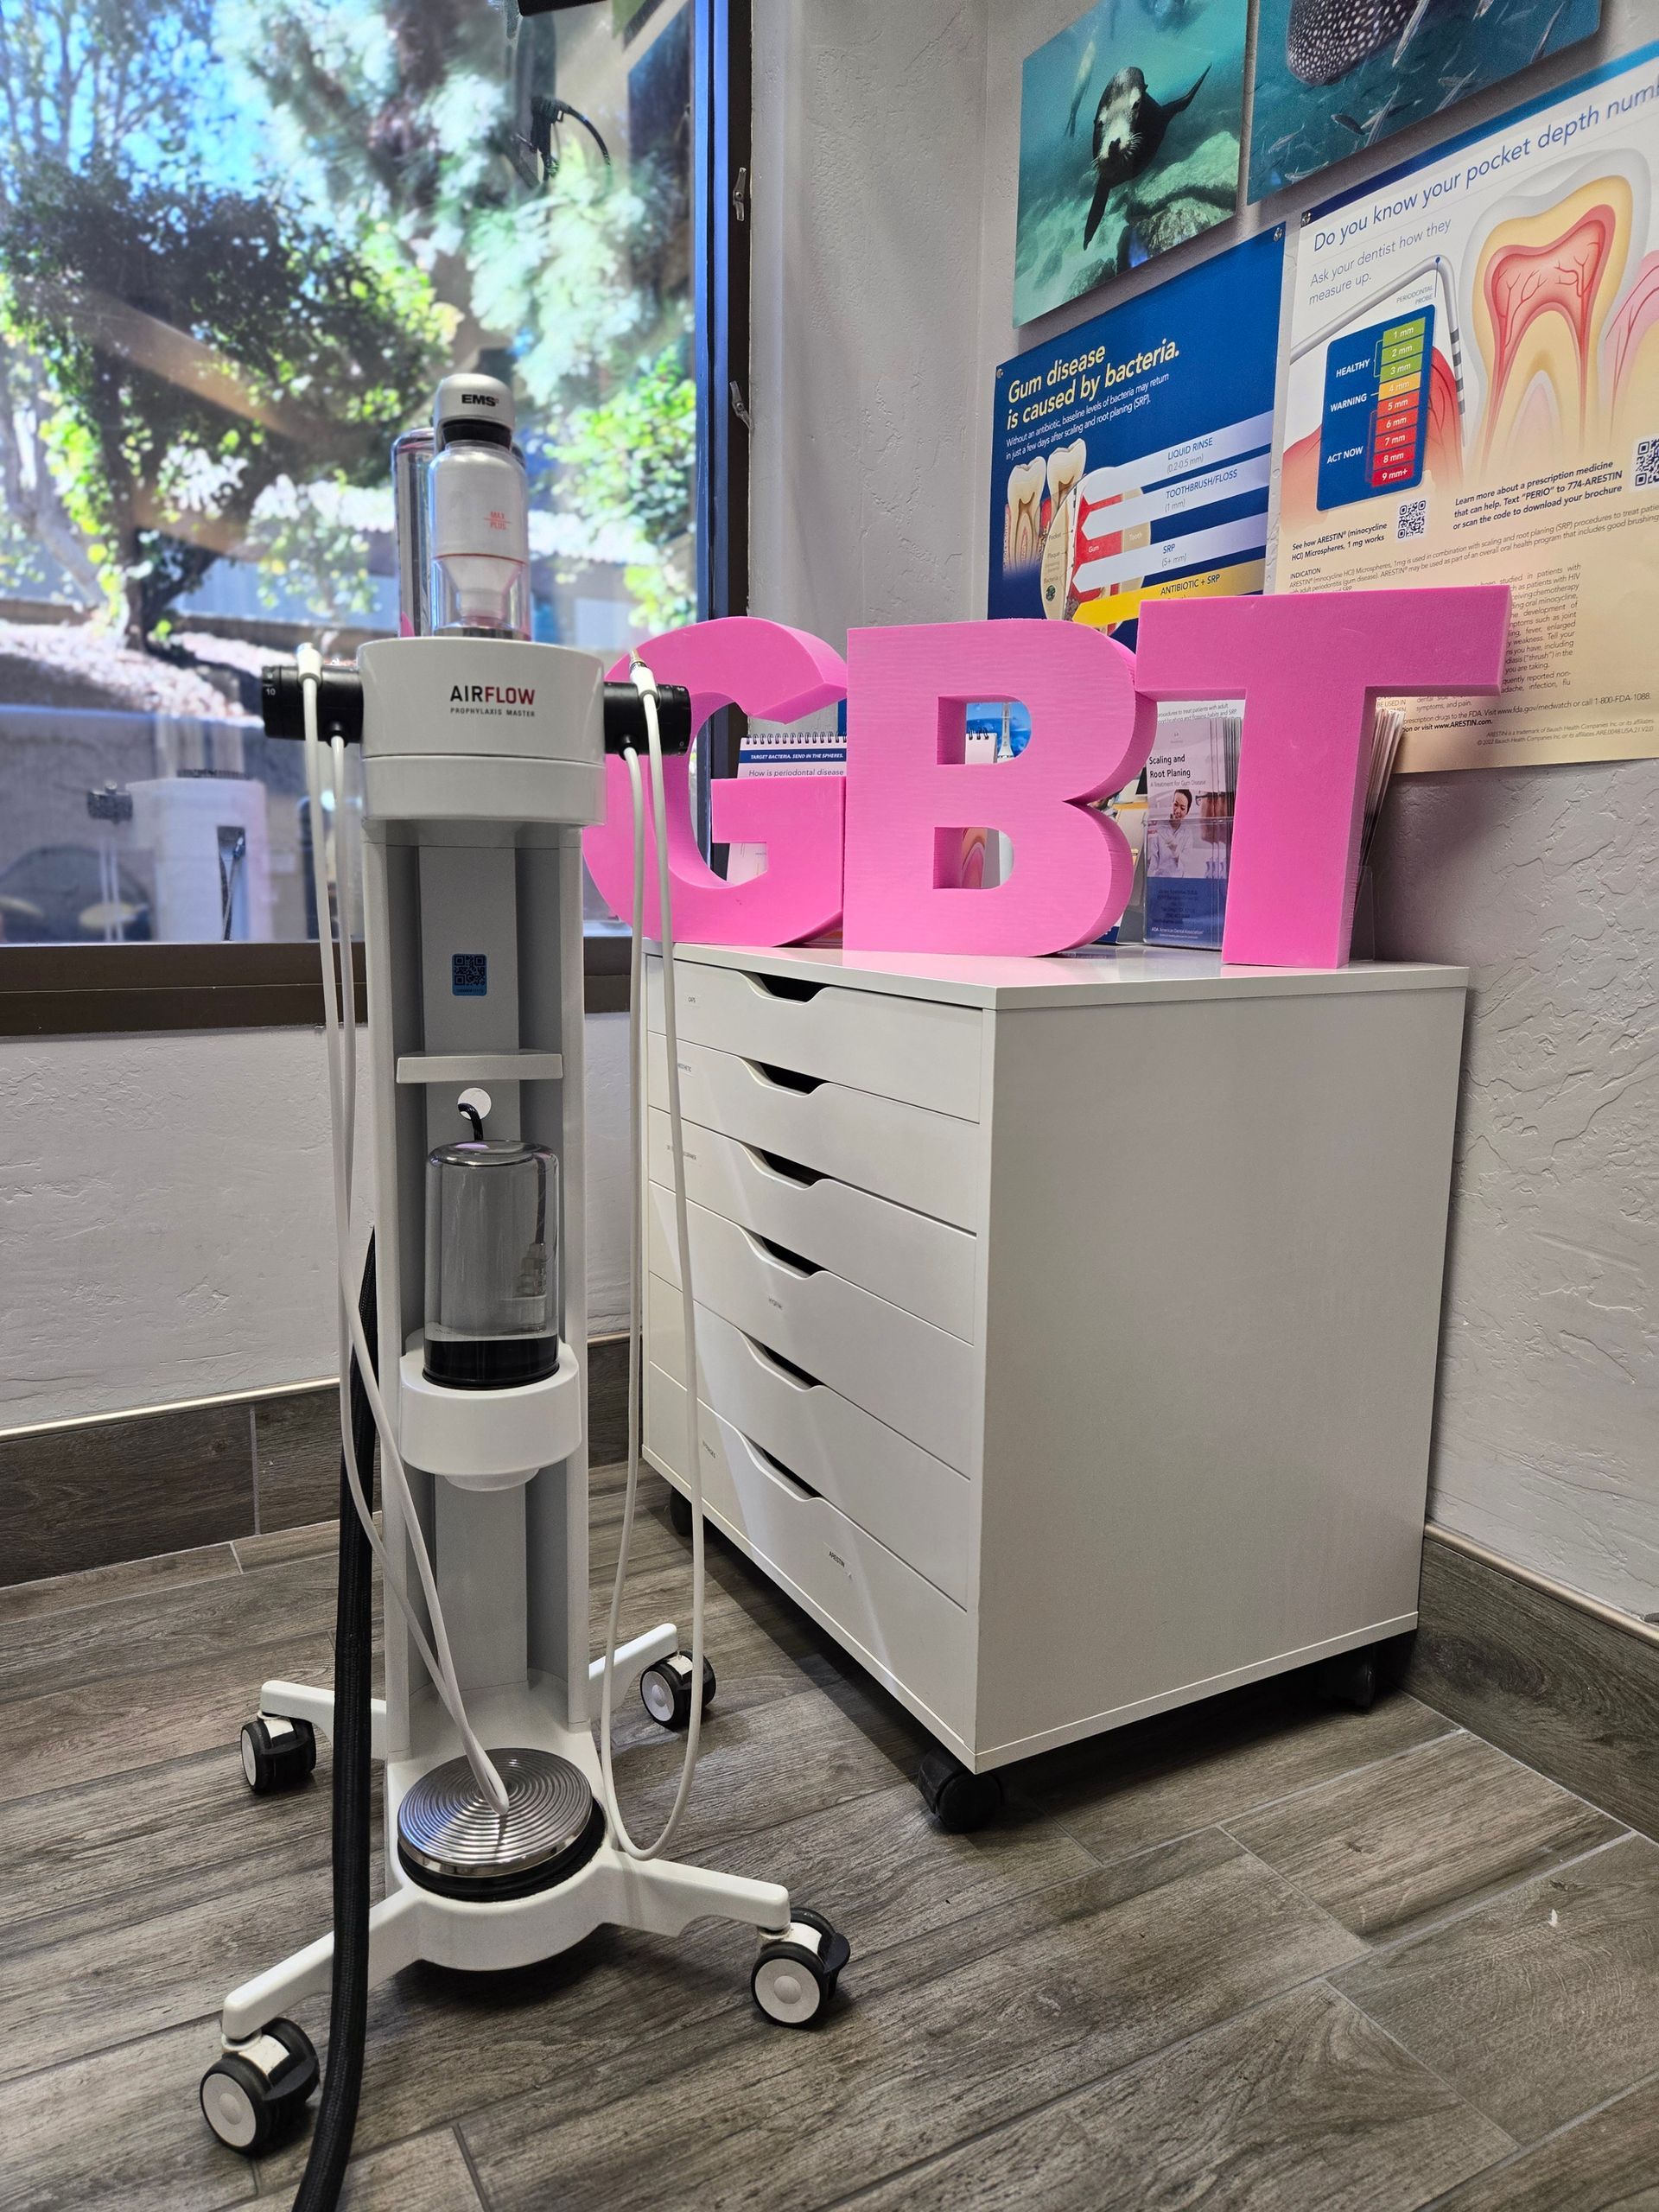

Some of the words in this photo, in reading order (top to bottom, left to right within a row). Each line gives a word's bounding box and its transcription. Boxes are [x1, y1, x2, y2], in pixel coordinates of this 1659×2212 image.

[1314, 232, 1335, 251] Do
[1339, 217, 1368, 245] you
[1373, 194, 1417, 225] know
[1421, 173, 1461, 208] your
[1465, 138, 1530, 190] pocket
[1538, 105, 1599, 145] depth
[1606, 73, 1659, 119] num
[1310, 270, 1328, 287] Ask
[1332, 259, 1354, 282] your
[1357, 242, 1395, 266] dentist
[1399, 232, 1423, 249] how
[1427, 219, 1451, 237] they
[1309, 280, 1352, 305] measure
[1355, 272, 1371, 287] up.
[1396, 285, 1433, 303] PERIODONTAL
[1414, 293, 1433, 305] PROBE
[1400, 327, 1414, 337] mm
[1399, 345, 1413, 354] mm
[1336, 359, 1370, 378] HEALTHY
[1397, 363, 1411, 372] mm
[1008, 376, 1041, 404] Gum
[1047, 346, 1105, 386] disease
[1007, 409, 1019, 430] is
[1023, 379, 1076, 423] caused
[1080, 374, 1100, 401] by
[1104, 338, 1179, 388] bacteria.
[1395, 380, 1409, 390] mm
[461, 394, 496, 406] EMS
[1330, 393, 1367, 412] WARNING
[1388, 402, 1393, 410] 5
[1395, 398, 1408, 408] mm
[1006, 434, 1027, 448] Without
[1036, 419, 1061, 435] antibiotic,
[1062, 410, 1085, 424] baseline
[1086, 401, 1102, 414] levels
[1103, 396, 1109, 407] of
[1109, 387, 1135, 404] bacteria
[1135, 382, 1149, 394] may
[1150, 373, 1169, 387] return
[1011, 448, 1021, 461] just
[1027, 442, 1037, 452] few
[1037, 437, 1050, 448] days
[1051, 431, 1064, 442] after
[1065, 423, 1084, 437] scaling
[1084, 416, 1096, 429] and
[1096, 412, 1109, 423] root
[1109, 404, 1133, 421] planing
[1134, 394, 1151, 410] (SRP).
[1386, 420, 1391, 429] 6
[1393, 416, 1407, 427] mm
[1385, 437, 1389, 446] 7
[1391, 435, 1405, 444] mm
[1167, 446, 1191, 461] LIQUID
[1192, 437, 1212, 451] RINSE
[1326, 453, 1342, 464] ACT
[1343, 446, 1363, 459] NOW
[1190, 453, 1204, 466] mm)
[1390, 452, 1404, 461] mm
[1389, 468, 1408, 480] mm+
[1166, 468, 1237, 499] TOOTHBRUSH/FLOSS
[1455, 497, 1475, 506] Learn
[1476, 490, 1495, 500] more
[1497, 483, 1518, 495] about
[1527, 471, 1573, 490] prescription
[1576, 461, 1613, 476] medicine
[1454, 509, 1469, 518] that
[1484, 499, 1502, 512] help.
[1503, 495, 1519, 505] Text
[1567, 470, 1623, 491] 774-ARESTIN
[1165, 503, 1169, 512] (1
[1172, 499, 1185, 510] mm)
[1462, 519, 1478, 528] scan
[1479, 513, 1491, 524] the
[1493, 510, 1511, 520] code
[1513, 507, 1521, 516] to
[1522, 499, 1562, 513] download
[1563, 493, 1583, 506] your
[1584, 485, 1622, 499] brochure
[1304, 539, 1316, 548] how
[1347, 523, 1388, 537] (minocycline
[1433, 546, 1467, 558] combination
[1468, 542, 1480, 550] with
[1481, 537, 1502, 547] scaling
[1503, 533, 1515, 543] and
[1530, 527, 1554, 537] planing
[1555, 521, 1573, 531] (SRP)
[1573, 515, 1612, 528] procedures
[1623, 508, 1639, 517] treat
[1163, 543, 1175, 554] SRP
[1305, 543, 1345, 558] Microspheres,
[1364, 534, 1384, 544] works
[1162, 557, 1171, 567] (5+
[1173, 553, 1187, 563] mm)
[1290, 567, 1321, 579] INDICATION
[1537, 568, 1563, 577] patients
[1567, 563, 1581, 571] with
[1160, 579, 1199, 595] ANTIBIOTIC
[1207, 574, 1220, 584] SRP
[1533, 584, 1580, 596] chemotherapy
[450, 685, 535, 705] AIRFLOW
[506, 709, 536, 717] MASTER
[1434, 720, 1493, 729] www.ARESTIN.com.
[1149, 755, 1172, 766] Scaling
[1174, 753, 1185, 762] and
[773, 768, 816, 777] periodontal
[1166, 768, 1191, 779] Planing
